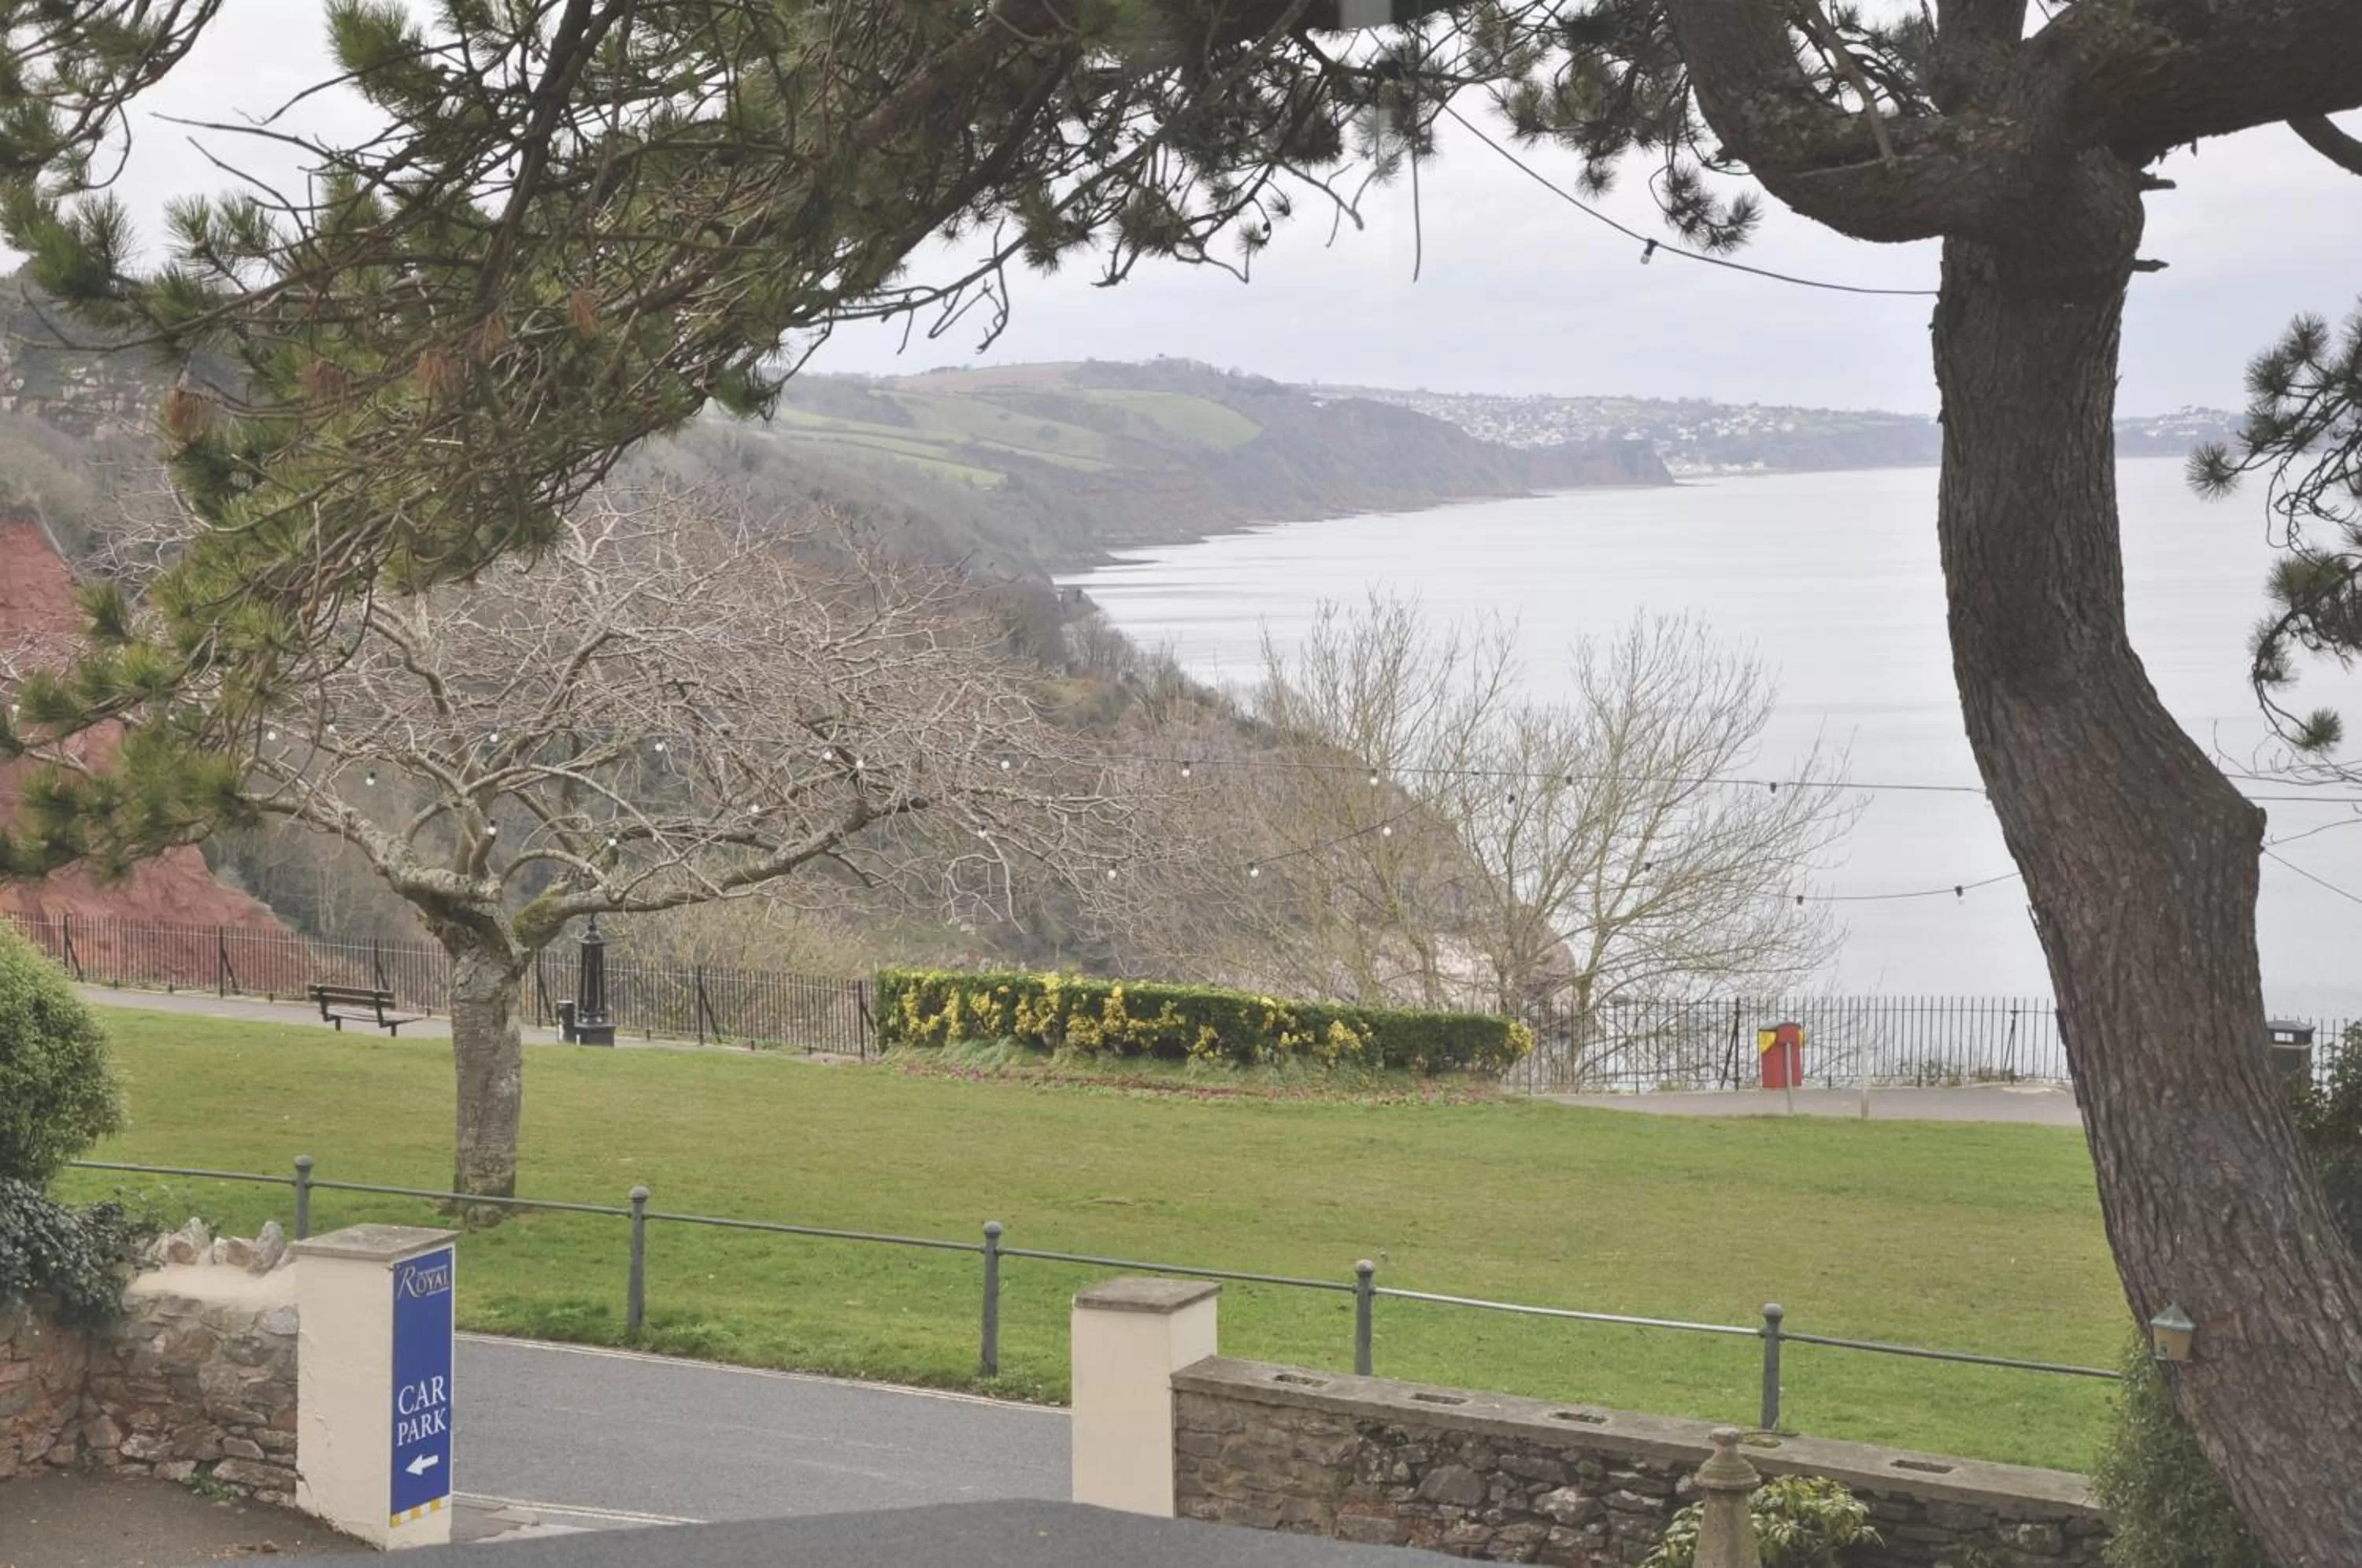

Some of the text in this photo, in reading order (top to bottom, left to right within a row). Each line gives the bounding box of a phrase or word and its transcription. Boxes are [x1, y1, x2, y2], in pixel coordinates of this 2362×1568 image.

[396, 1265, 449, 1300] ROYAL
[398, 1375, 446, 1415] CAR
[397, 1407, 446, 1447] PARK
